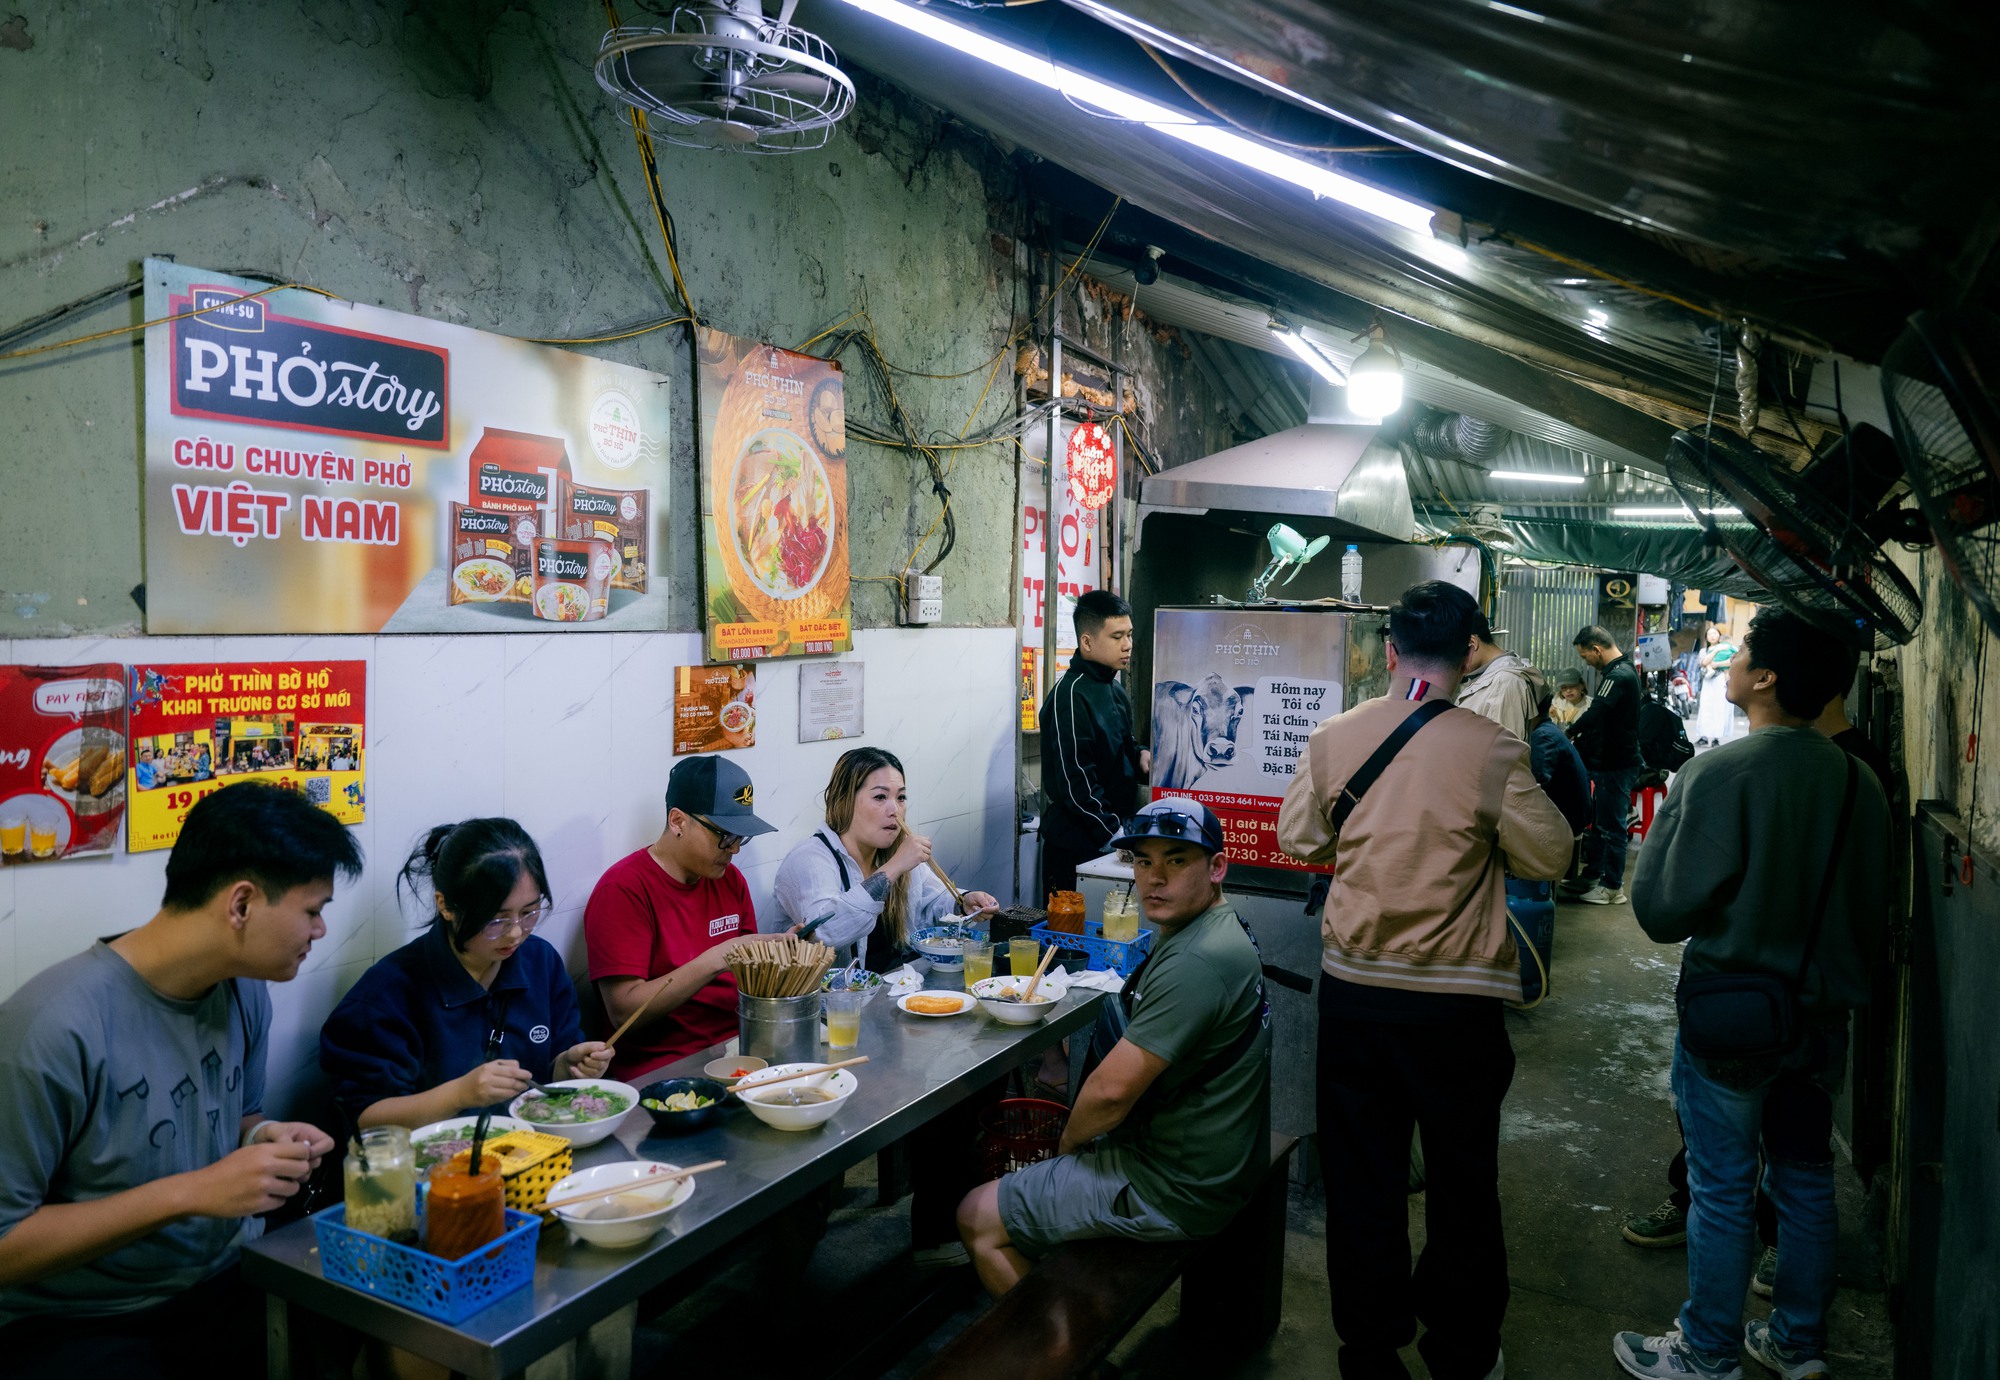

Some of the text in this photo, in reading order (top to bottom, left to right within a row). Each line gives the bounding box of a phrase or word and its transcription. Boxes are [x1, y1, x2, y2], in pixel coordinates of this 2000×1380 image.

[203, 298, 254, 319] CHIN-SU
[185, 338, 440, 431] PHỞ story
[745, 366, 805, 396] PHỞ THÌN
[608, 425, 637, 443] THÌN
[174, 437, 411, 487] CÂU CHUYỆN PHỞ
[481, 474, 546, 499] PHỞ story
[176, 484, 396, 543] VIỆT NAM
[482, 500, 501, 510] BÁNH
[573, 497, 596, 511] PHỞ
[595, 500, 617, 515] story
[460, 515, 486, 530] PHỞ
[485, 518, 509, 533] story
[539, 555, 564, 574] PHỞ
[564, 560, 588, 578] story
[722, 627, 738, 636] BÁT
[800, 623, 812, 632] BÁT
[1215, 639, 1280, 656] PHỞ THÌN
[185, 667, 333, 693] PHỞ THÌN BỜ HỒ
[45, 693, 70, 705] PAY
[1271, 682, 1326, 699] Hôm nay
[162, 689, 351, 716] KHAI TRƯƠNG CƠ SỞ MỚI
[1281, 698, 1320, 710] Tôi có
[1263, 714, 1309, 726] Tái Chín
[1263, 730, 1309, 745] Tái Nạm
[1265, 745, 1282, 757] Tái
[1262, 762, 1296, 776] Đặc Bi
[167, 791, 193, 810] 19
[1215, 796, 1236, 804] 9253
[1236, 797, 1252, 805] 464
[1236, 819, 1258, 829] GIỜ
[1261, 821, 1277, 831] BÁ
[152, 832, 179, 841] Hotli
[1222, 831, 1258, 845] 13:00
[1223, 847, 1258, 861] 17:30
